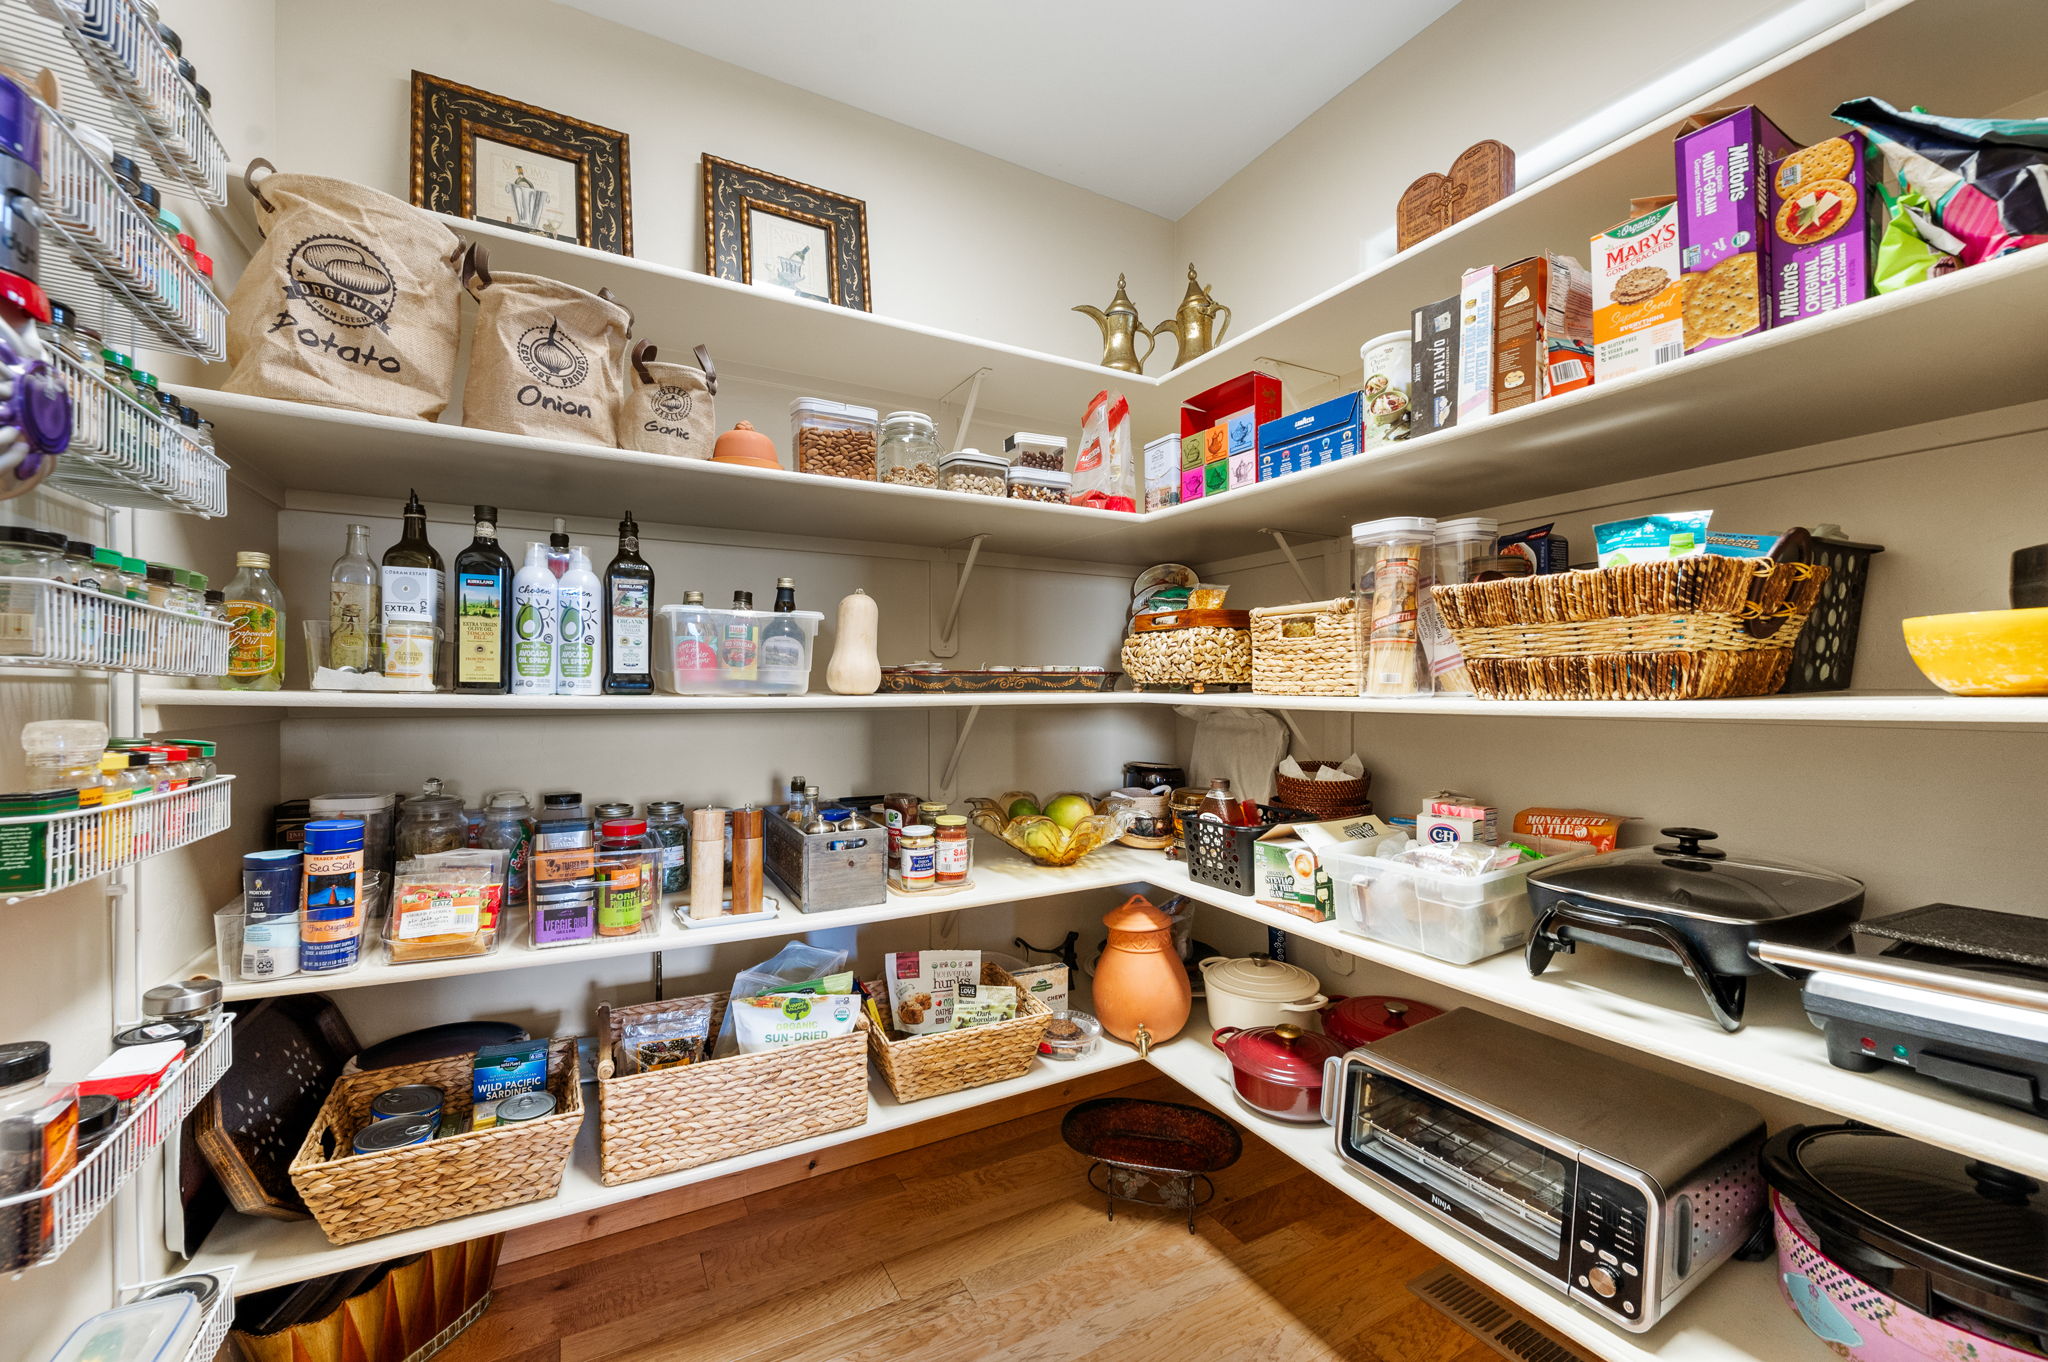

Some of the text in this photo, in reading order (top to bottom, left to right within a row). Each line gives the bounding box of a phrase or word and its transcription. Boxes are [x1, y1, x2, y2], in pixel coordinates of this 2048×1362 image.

[1702, 150, 1717, 216] MULTI-GRAIN
[1621, 214, 1656, 237] Organic
[1606, 223, 1675, 269] MARY'S
[1606, 241, 1674, 277] GONE CRACKERS
[1780, 262, 1799, 318] Milton's
[1805, 255, 1820, 313] ORIGINAL
[300, 282, 383, 322] ORGANIC
[312, 299, 369, 323] FARM FRESH
[1619, 313, 1664, 332] EVERYTHING
[267, 310, 400, 373] Potato
[521, 343, 551, 382] ECOLOGY
[562, 355, 586, 386] PRODUCT
[1432, 338, 1446, 395] OATMEAL
[517, 384, 592, 418] Onion
[644, 420, 690, 440] Garlic
[385, 604, 415, 613] EXTRA
[1526, 815, 1608, 826] MONK FRUIT
[1531, 824, 1574, 835] IN THE
[309, 860, 356, 872] Sea Salt
[610, 891, 636, 900] PORK
[545, 918, 573, 931] VEGGIE
[933, 969, 973, 979] heavenly
[1047, 994, 1066, 1002] CHEWY
[935, 1008, 954, 1016] OATME
[764, 1030, 828, 1042] SUN-DRIED
[776, 1021, 818, 1030] ORGANIC
